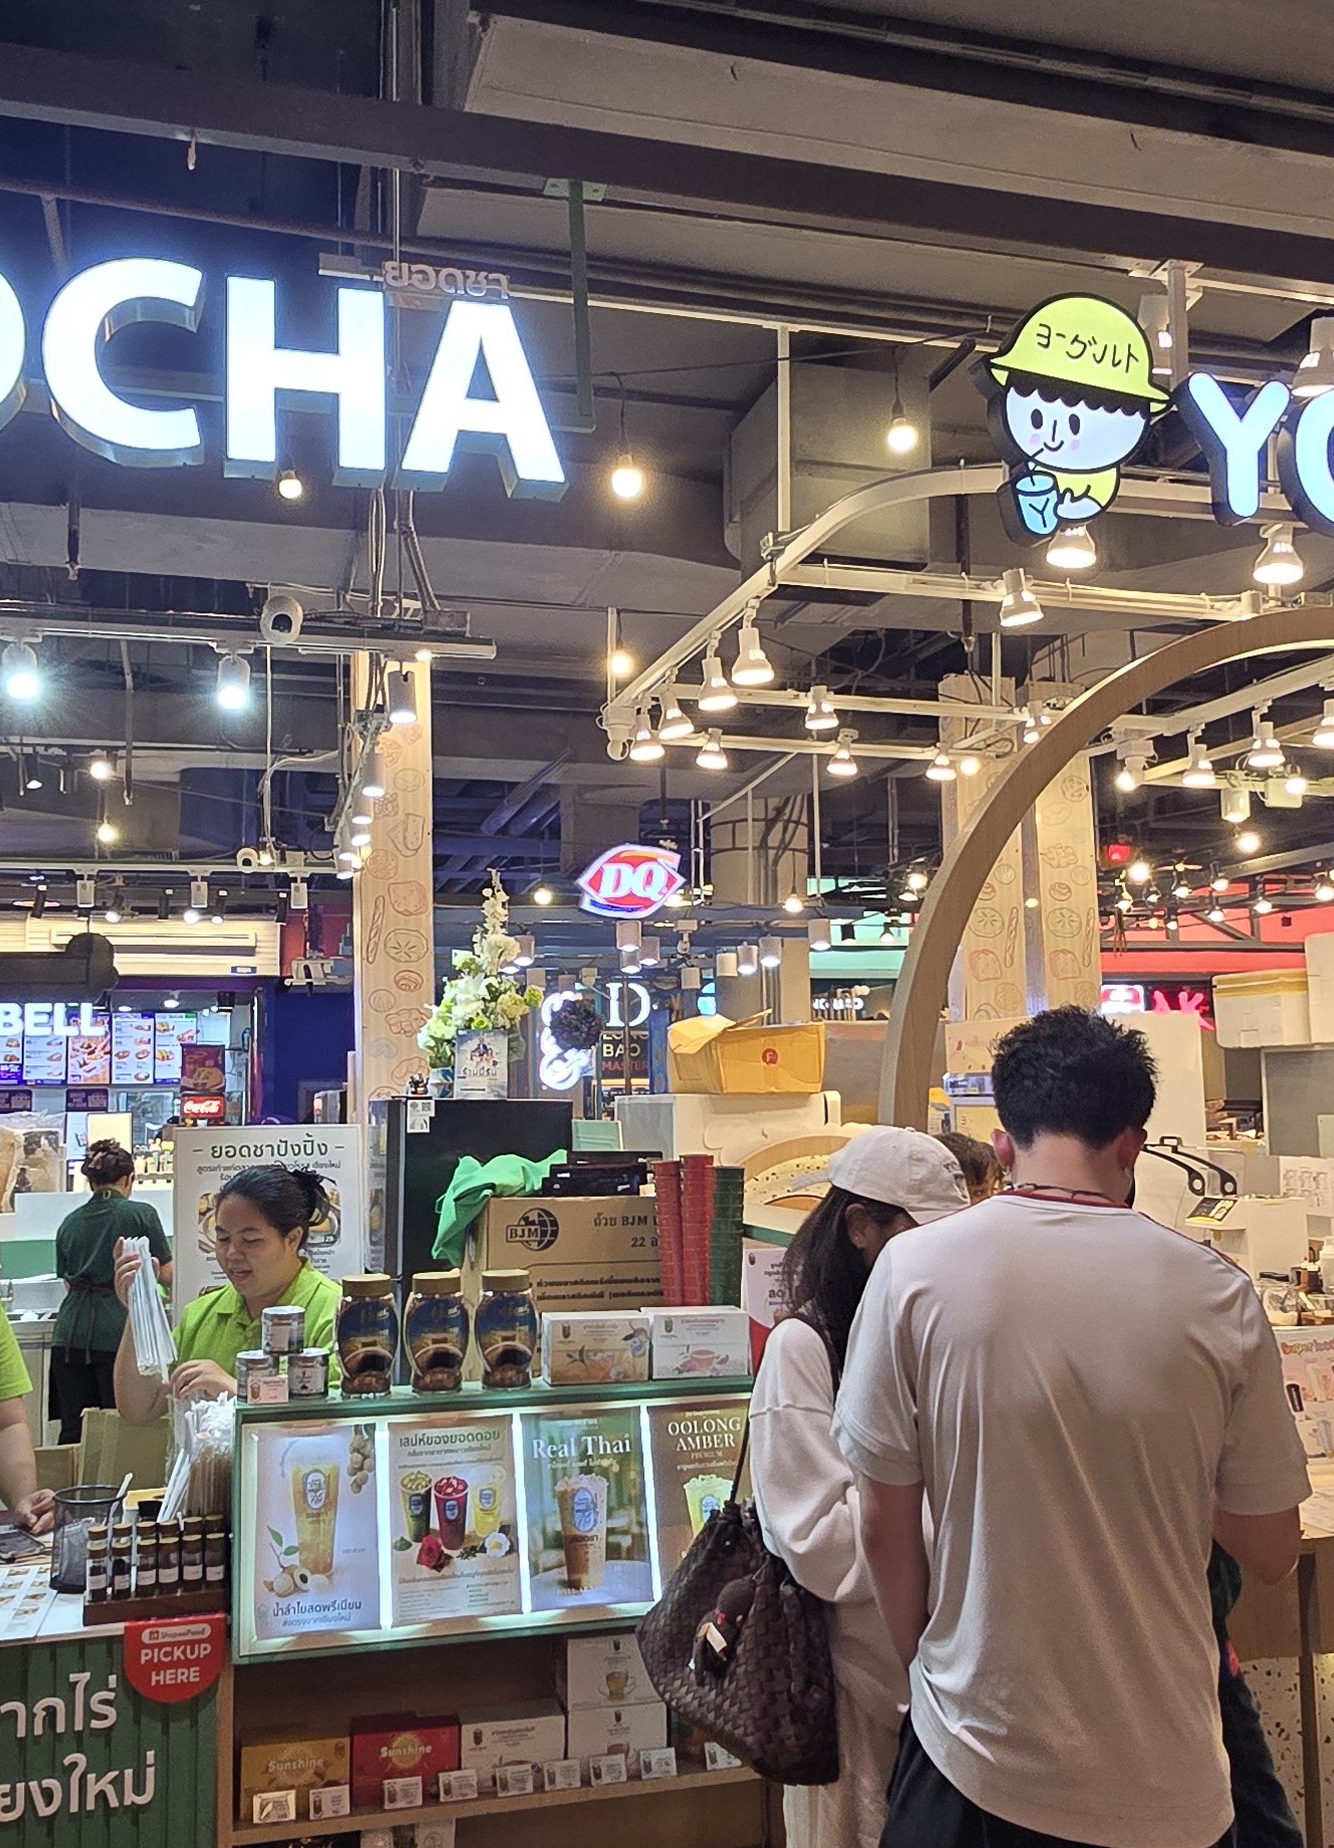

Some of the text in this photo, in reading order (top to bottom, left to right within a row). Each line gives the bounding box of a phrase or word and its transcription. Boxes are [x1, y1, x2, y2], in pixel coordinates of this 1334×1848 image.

[1035, 322, 1140, 374] ヨーグルト
[598, 862, 668, 902] DQ
[210, 1132, 329, 1159] ยอดชาปังปิ้ง
[621, 1214, 648, 1227] BJM
[509, 1227, 539, 1240] BJM
[630, 1236, 646, 1248] 22
[667, 1416, 742, 1437] OOLONG
[532, 1433, 632, 1459] Real Thai
[676, 1432, 736, 1452] AMBER
[140, 1642, 212, 1665] PICKUP
[151, 1666, 201, 1687] HERE
[380, 1742, 433, 1759] Sunshine
[268, 1757, 325, 1773] Sunshine
